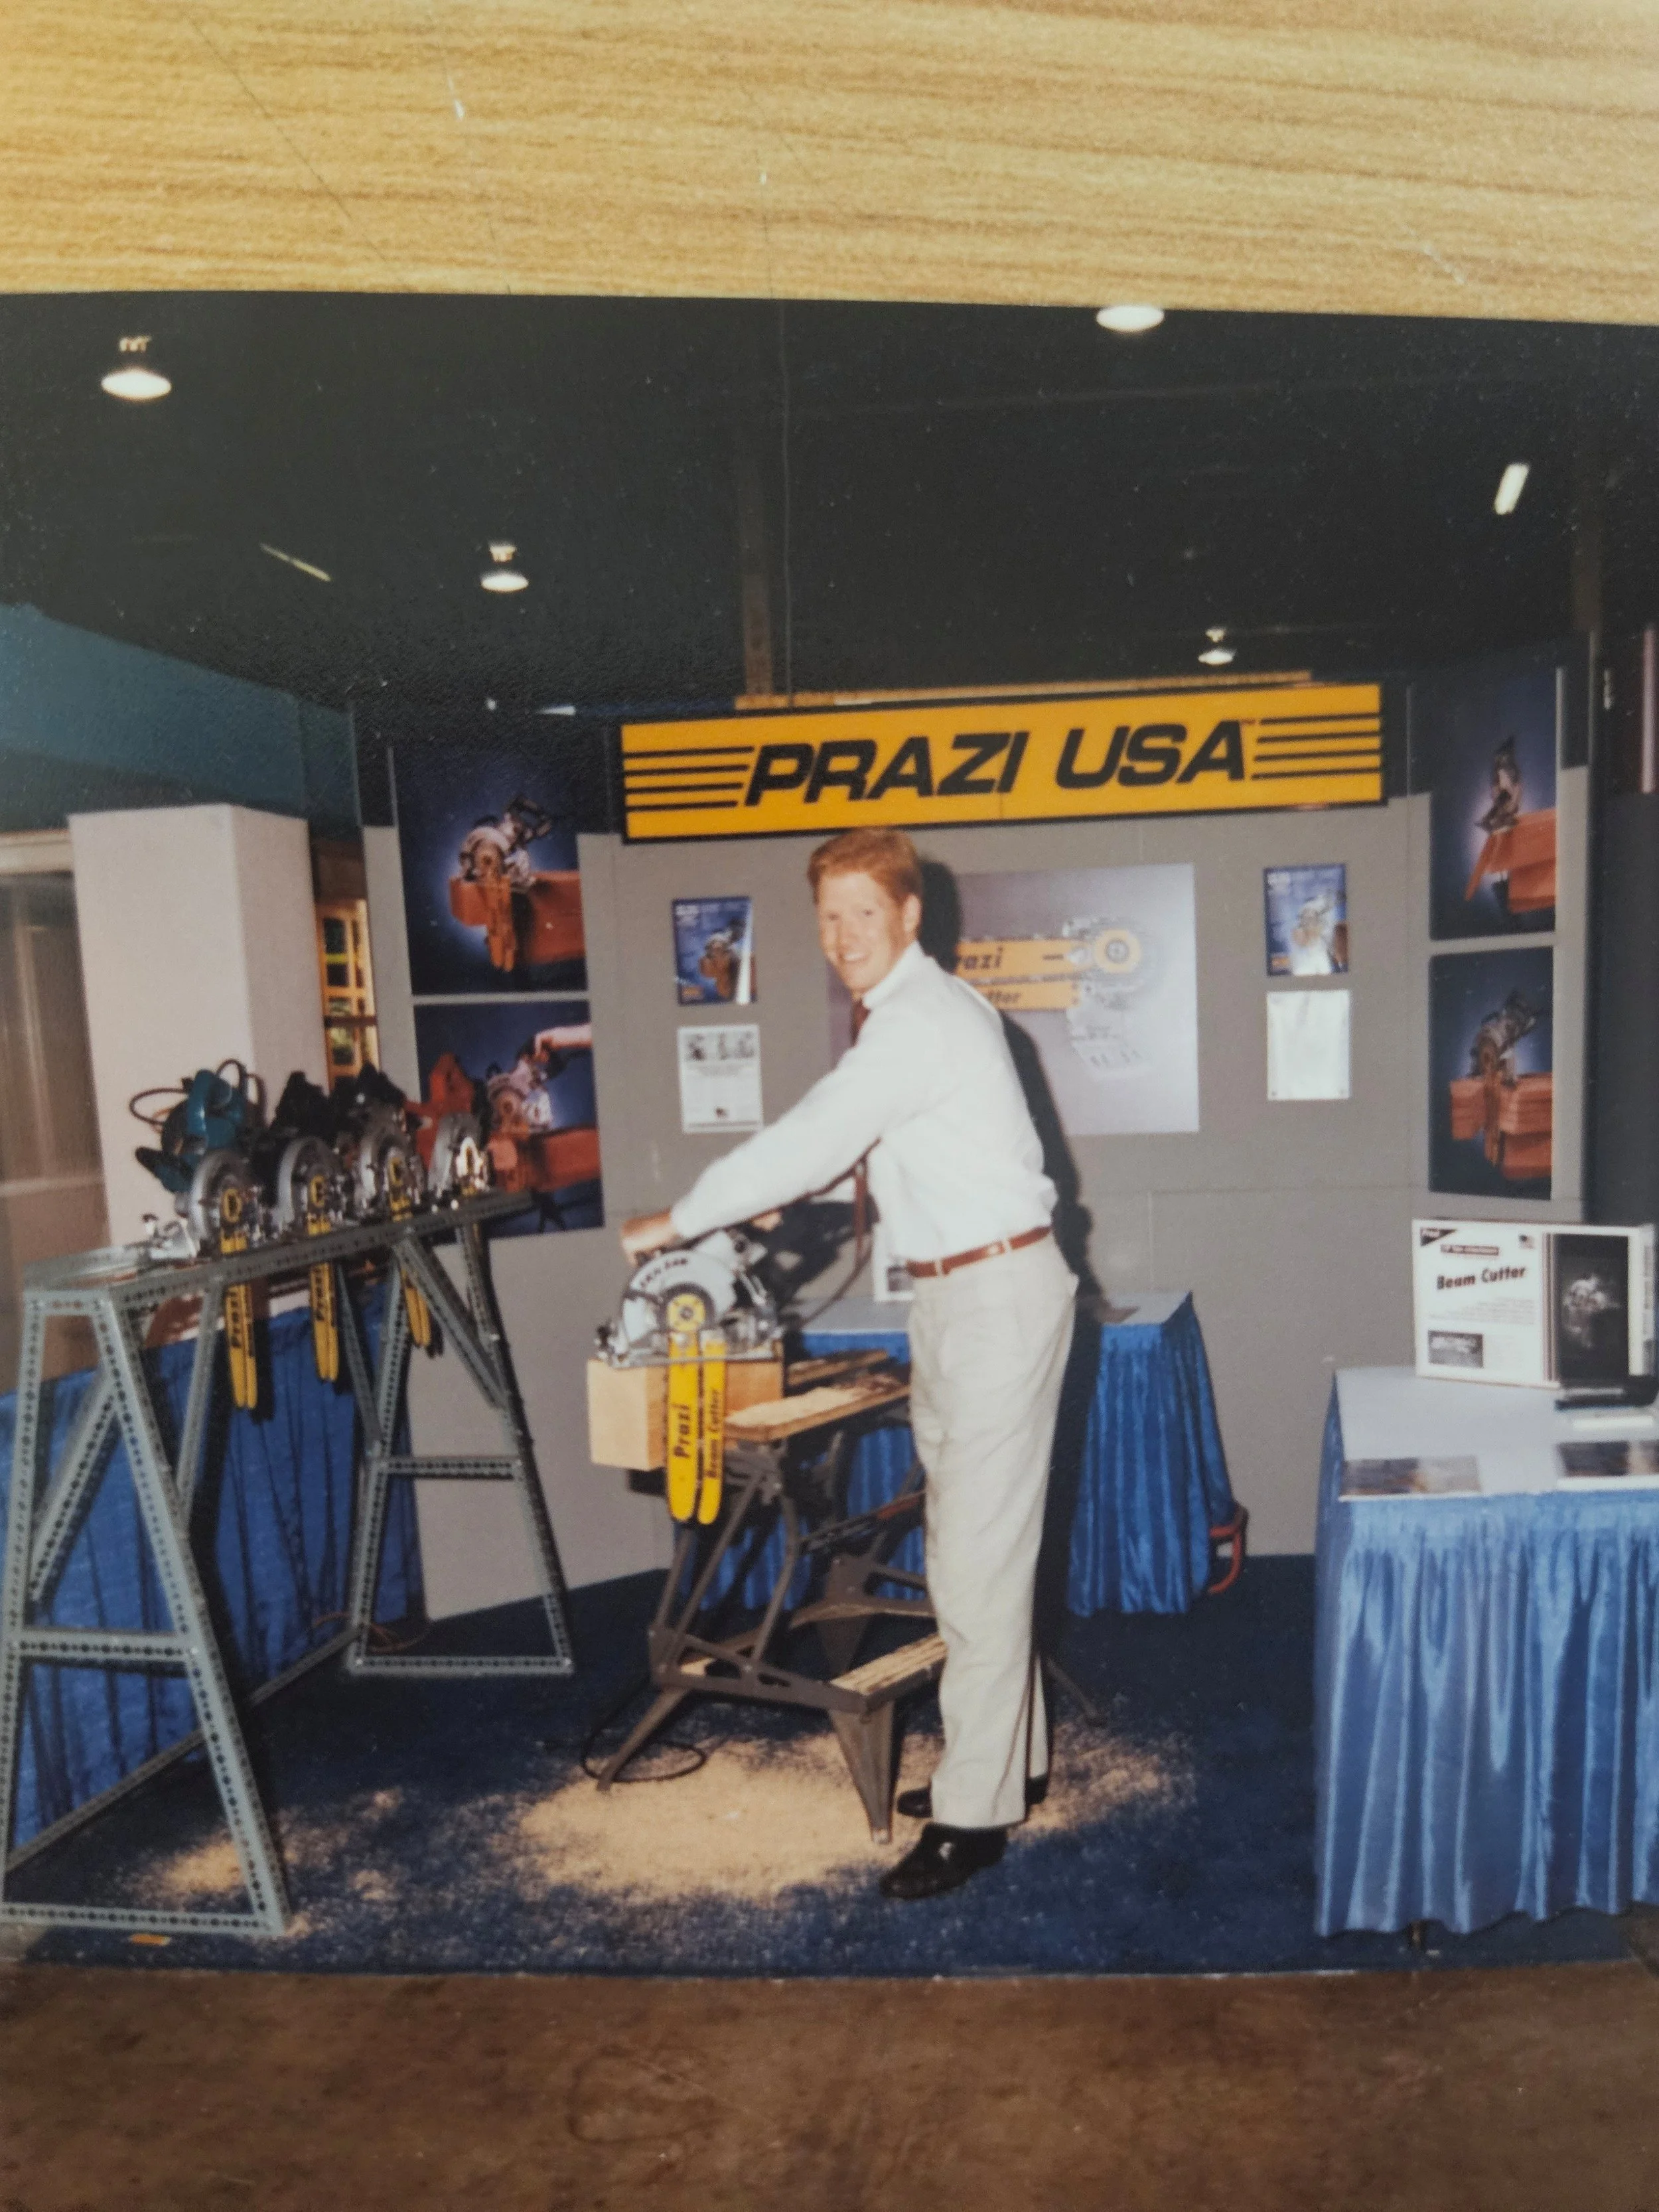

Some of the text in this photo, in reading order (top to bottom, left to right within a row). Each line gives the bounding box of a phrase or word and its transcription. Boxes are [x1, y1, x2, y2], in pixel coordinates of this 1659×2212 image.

[744, 719, 1244, 807] PRAZI USA
[960, 946, 1003, 970] azi
[1437, 1266, 1526, 1290] Beam Cutter
[672, 1404, 690, 1458] Prazi
